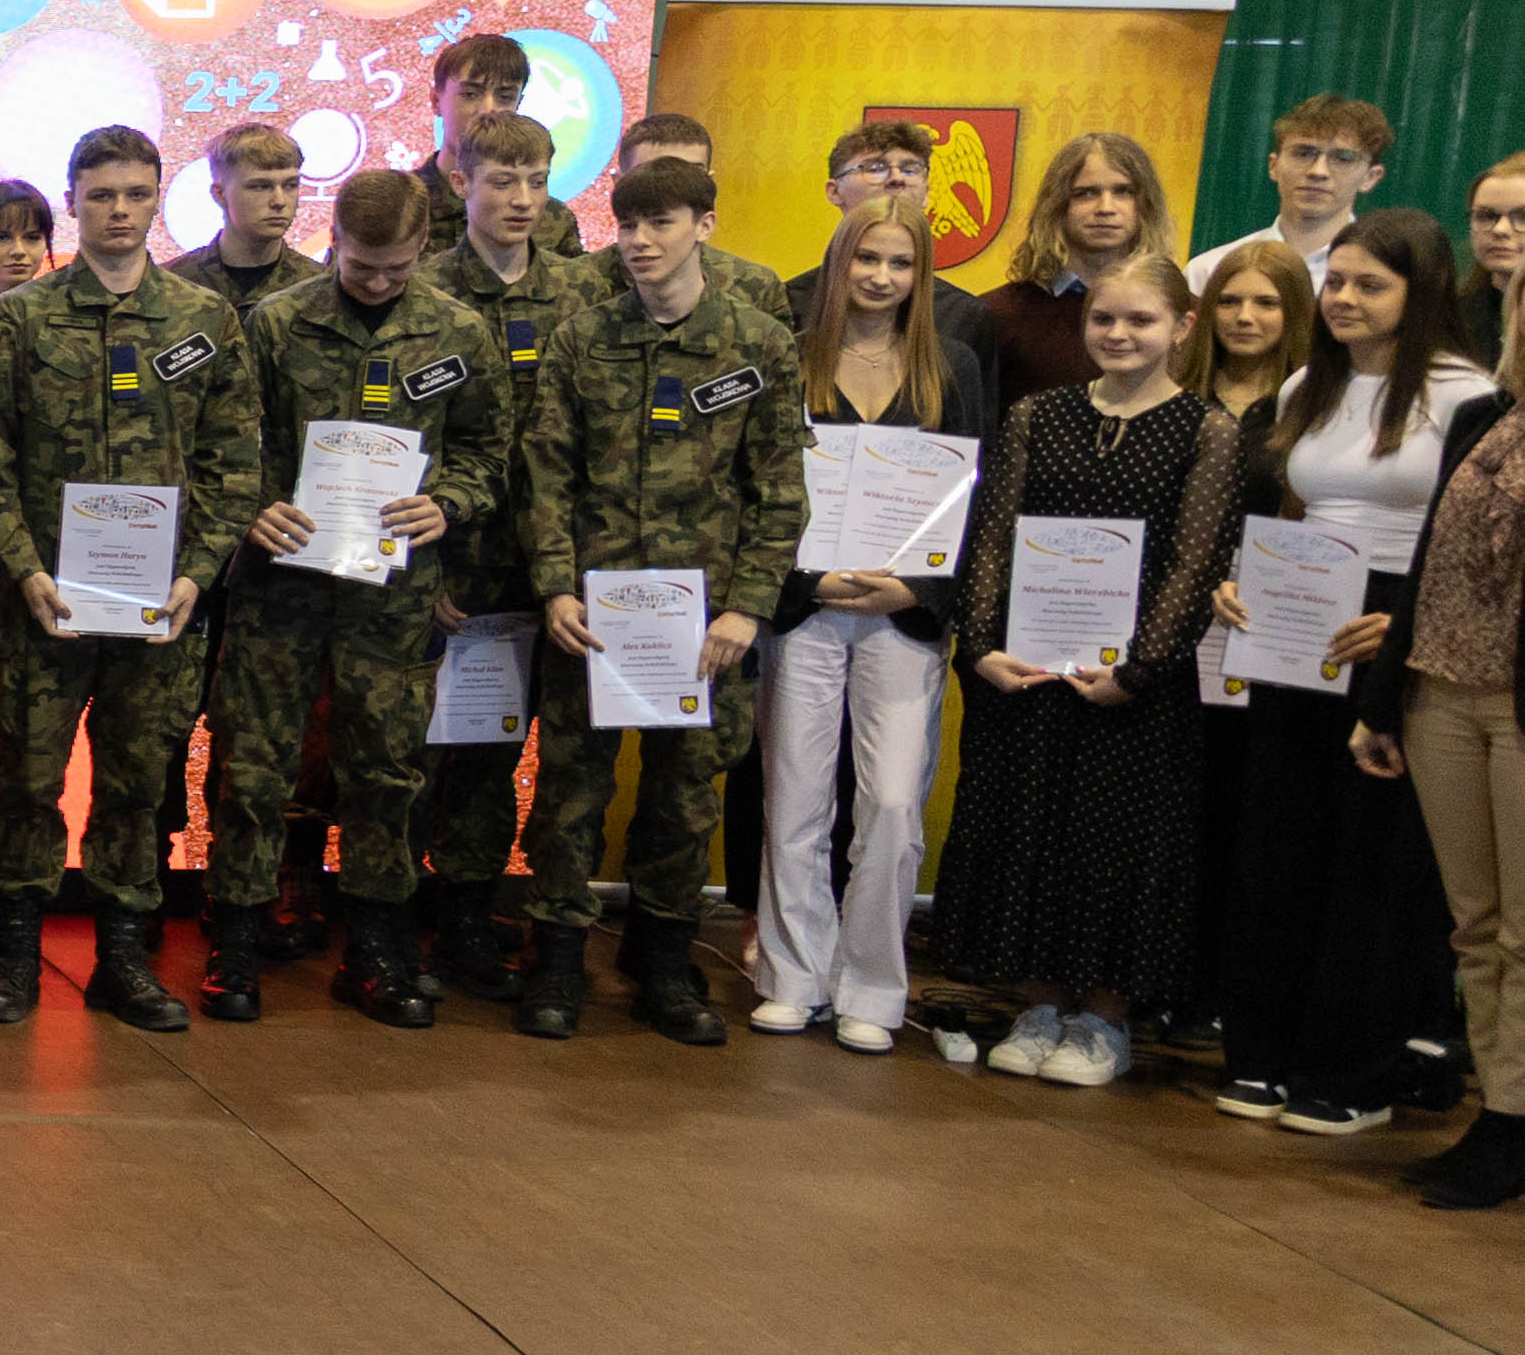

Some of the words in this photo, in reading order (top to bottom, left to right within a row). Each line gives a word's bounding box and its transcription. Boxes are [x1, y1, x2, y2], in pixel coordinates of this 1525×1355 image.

[359, 47, 404, 111] 5
[182, 71, 281, 112] 2+2
[170, 345, 194, 361] KLASA
[417, 371, 457, 392] WOJSKOWA
[422, 367, 446, 381] KLASA
[706, 383, 753, 404] WOJSKOWA
[712, 379, 740, 394] KLASA
